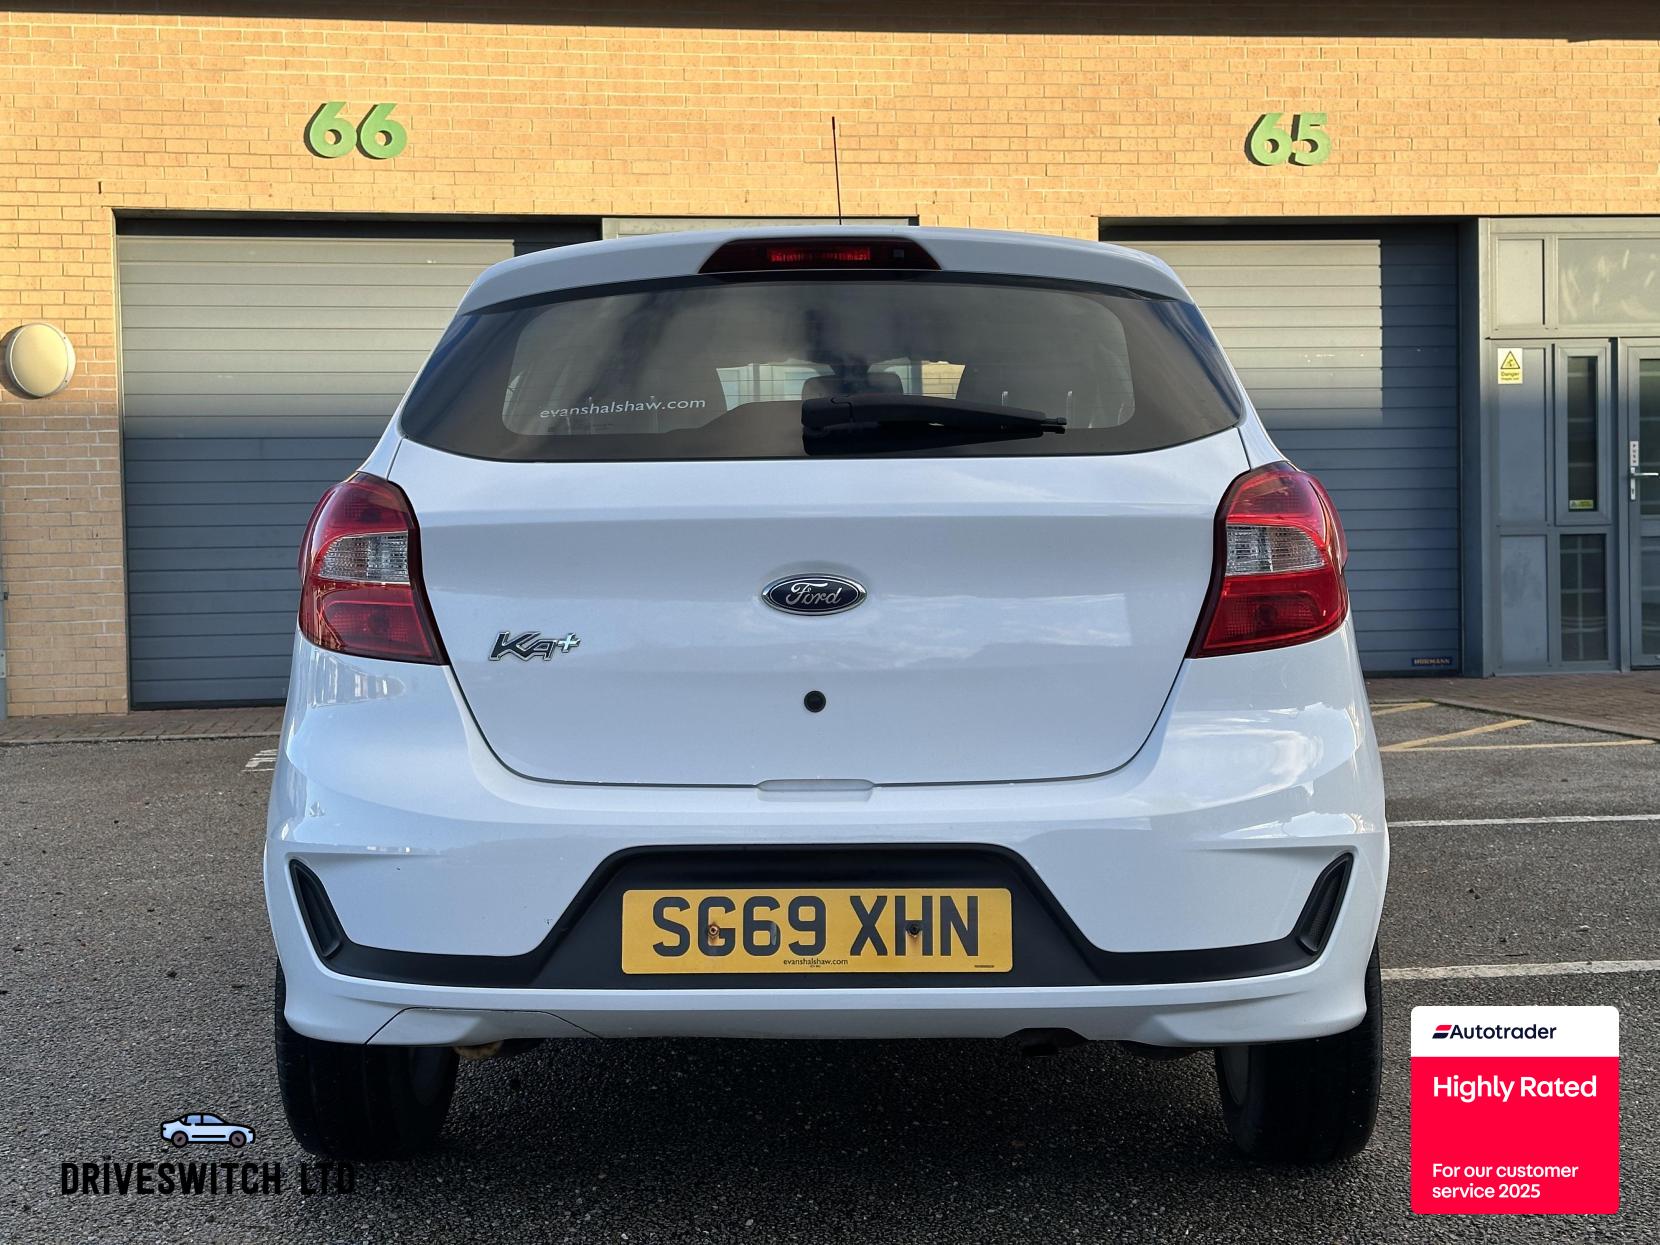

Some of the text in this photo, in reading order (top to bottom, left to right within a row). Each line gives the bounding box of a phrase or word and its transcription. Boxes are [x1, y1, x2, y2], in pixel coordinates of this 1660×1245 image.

[305, 101, 408, 159] 66
[1246, 112, 1332, 166] 65
[539, 400, 706, 419] evanshalshaw.com
[785, 582, 843, 605] Ford
[652, 895, 979, 958] SG69 XHN
